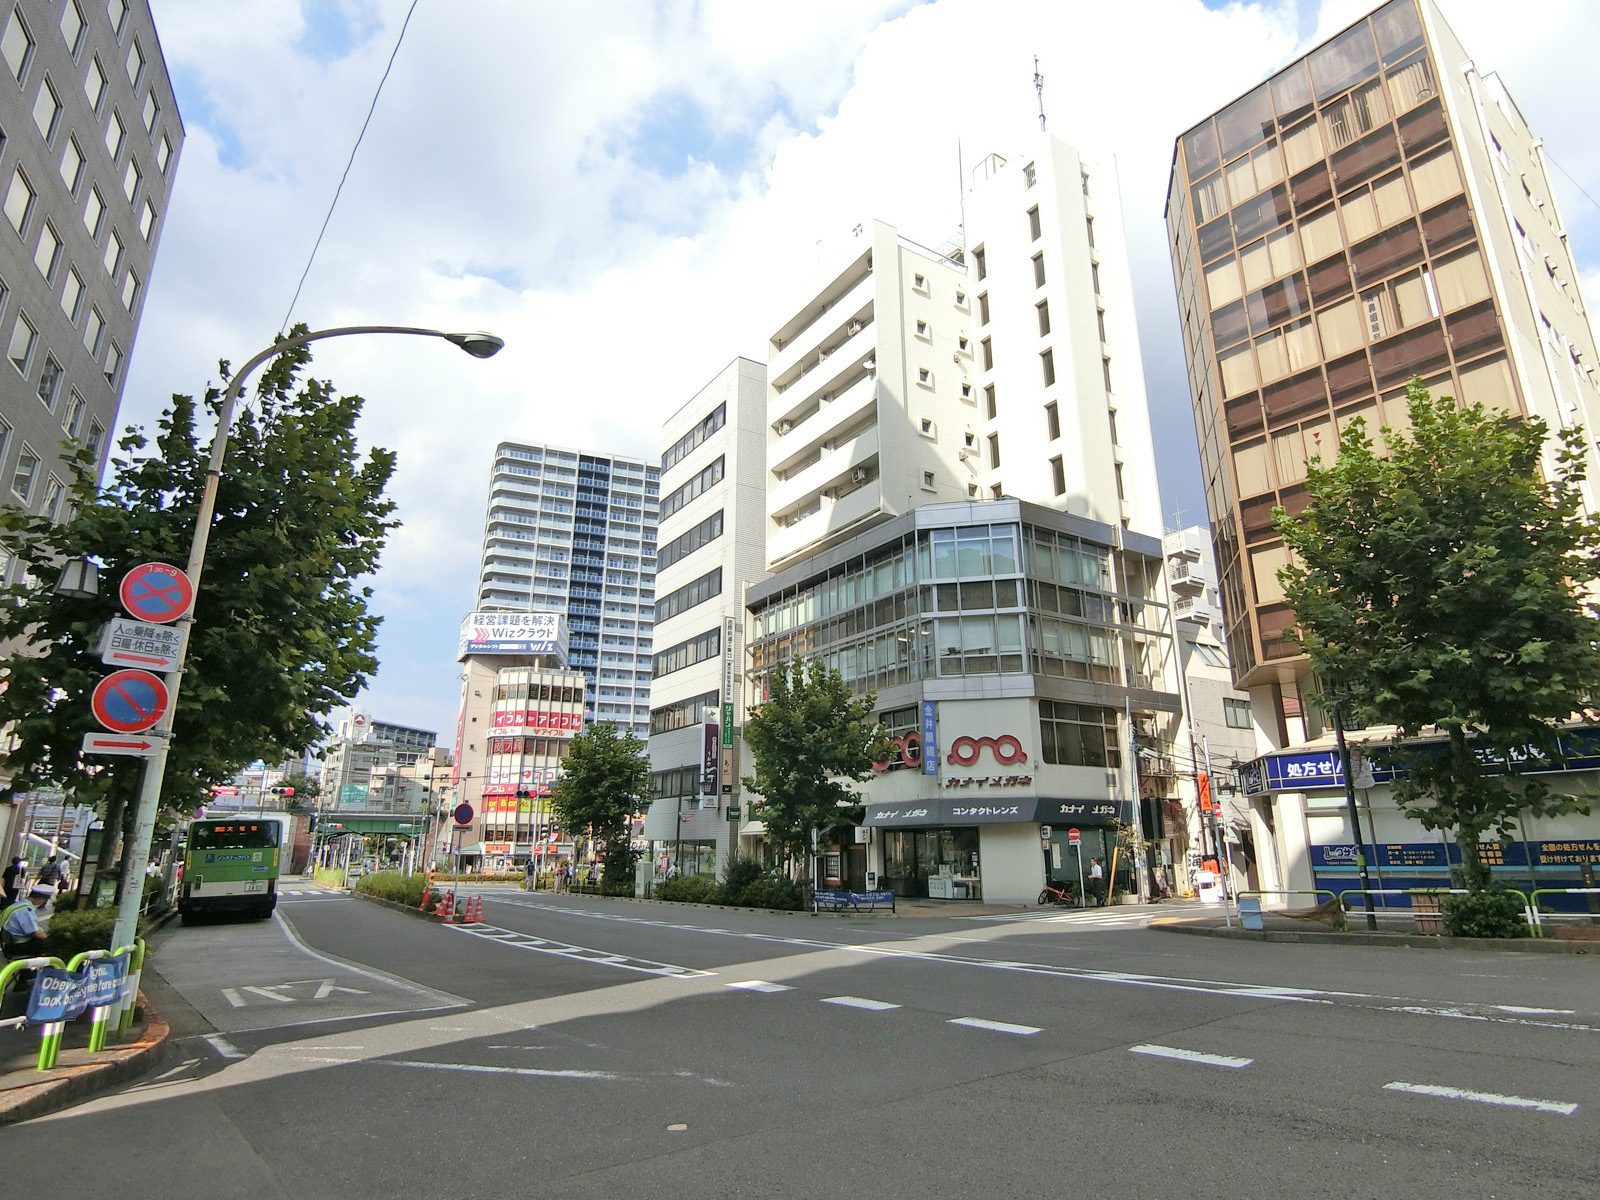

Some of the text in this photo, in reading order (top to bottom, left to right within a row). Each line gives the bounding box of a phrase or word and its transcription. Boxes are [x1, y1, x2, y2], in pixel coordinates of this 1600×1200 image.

[474, 615, 555, 626] 経営課題を解決
[114, 623, 180, 643] 人の乗降を除く
[541, 728, 564, 737] アイフル
[924, 704, 936, 772] 金井眼鏡店
[945, 776, 1032, 788] カナイメガネ
[486, 785, 505, 793] アコム
[875, 808, 928, 819] カナイ メガネ
[953, 806, 1019, 816] コンタクトレンズ
[1060, 804, 1116, 815] カナイ メガネ
[1541, 843, 1600, 852] 全国の処方せんを
[42, 977, 72, 993] Obey
[38, 995, 62, 1006] Look
